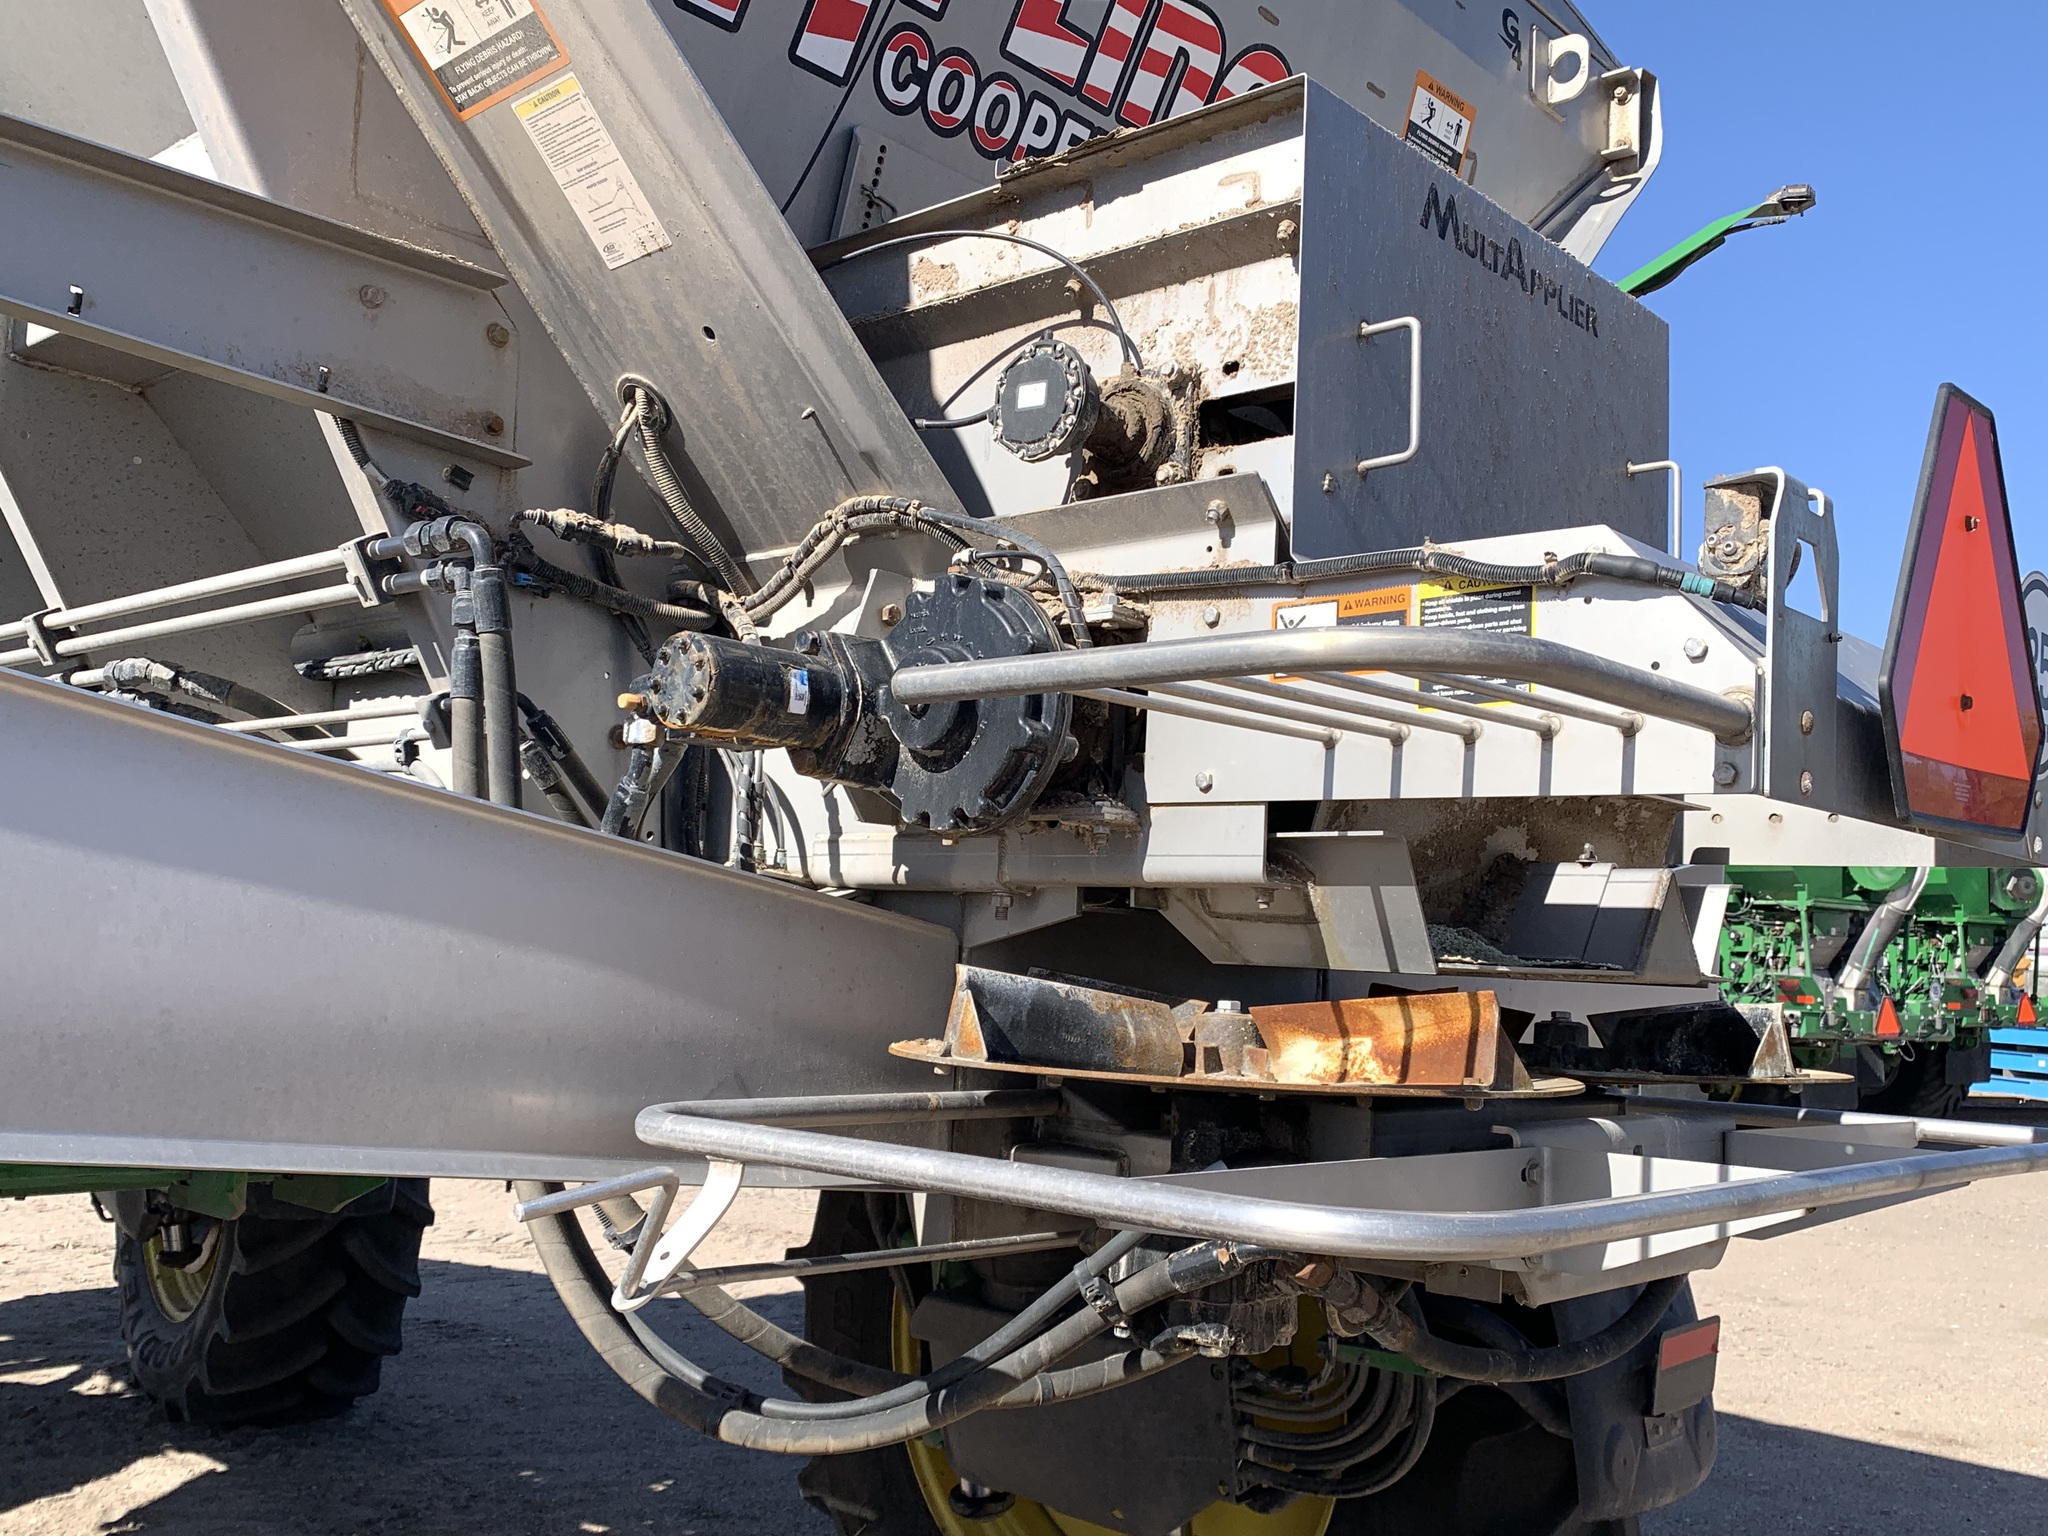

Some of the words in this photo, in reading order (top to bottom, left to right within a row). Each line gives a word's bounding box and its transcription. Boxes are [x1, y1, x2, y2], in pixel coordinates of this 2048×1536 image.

[481, 6, 495, 18] KEEP
[487, 15, 501, 27] AWAY
[454, 57, 477, 75] FLYING
[474, 45, 498, 63] DEBRIS
[449, 85, 457, 94] To
[456, 76, 475, 92] prevent
[474, 66, 492, 81] serious
[455, 90, 470, 104] STAY
[483, 69, 509, 88] OBJECTS
[506, 62, 520, 75] CAN
[519, 57, 529, 68] BE
[537, 88, 561, 105] CAUTION
[1436, 84, 1465, 112] WARNING
[1354, 593, 1406, 608] WARNING
[1485, 591, 1502, 600] during
[1502, 589, 1522, 598] normal
